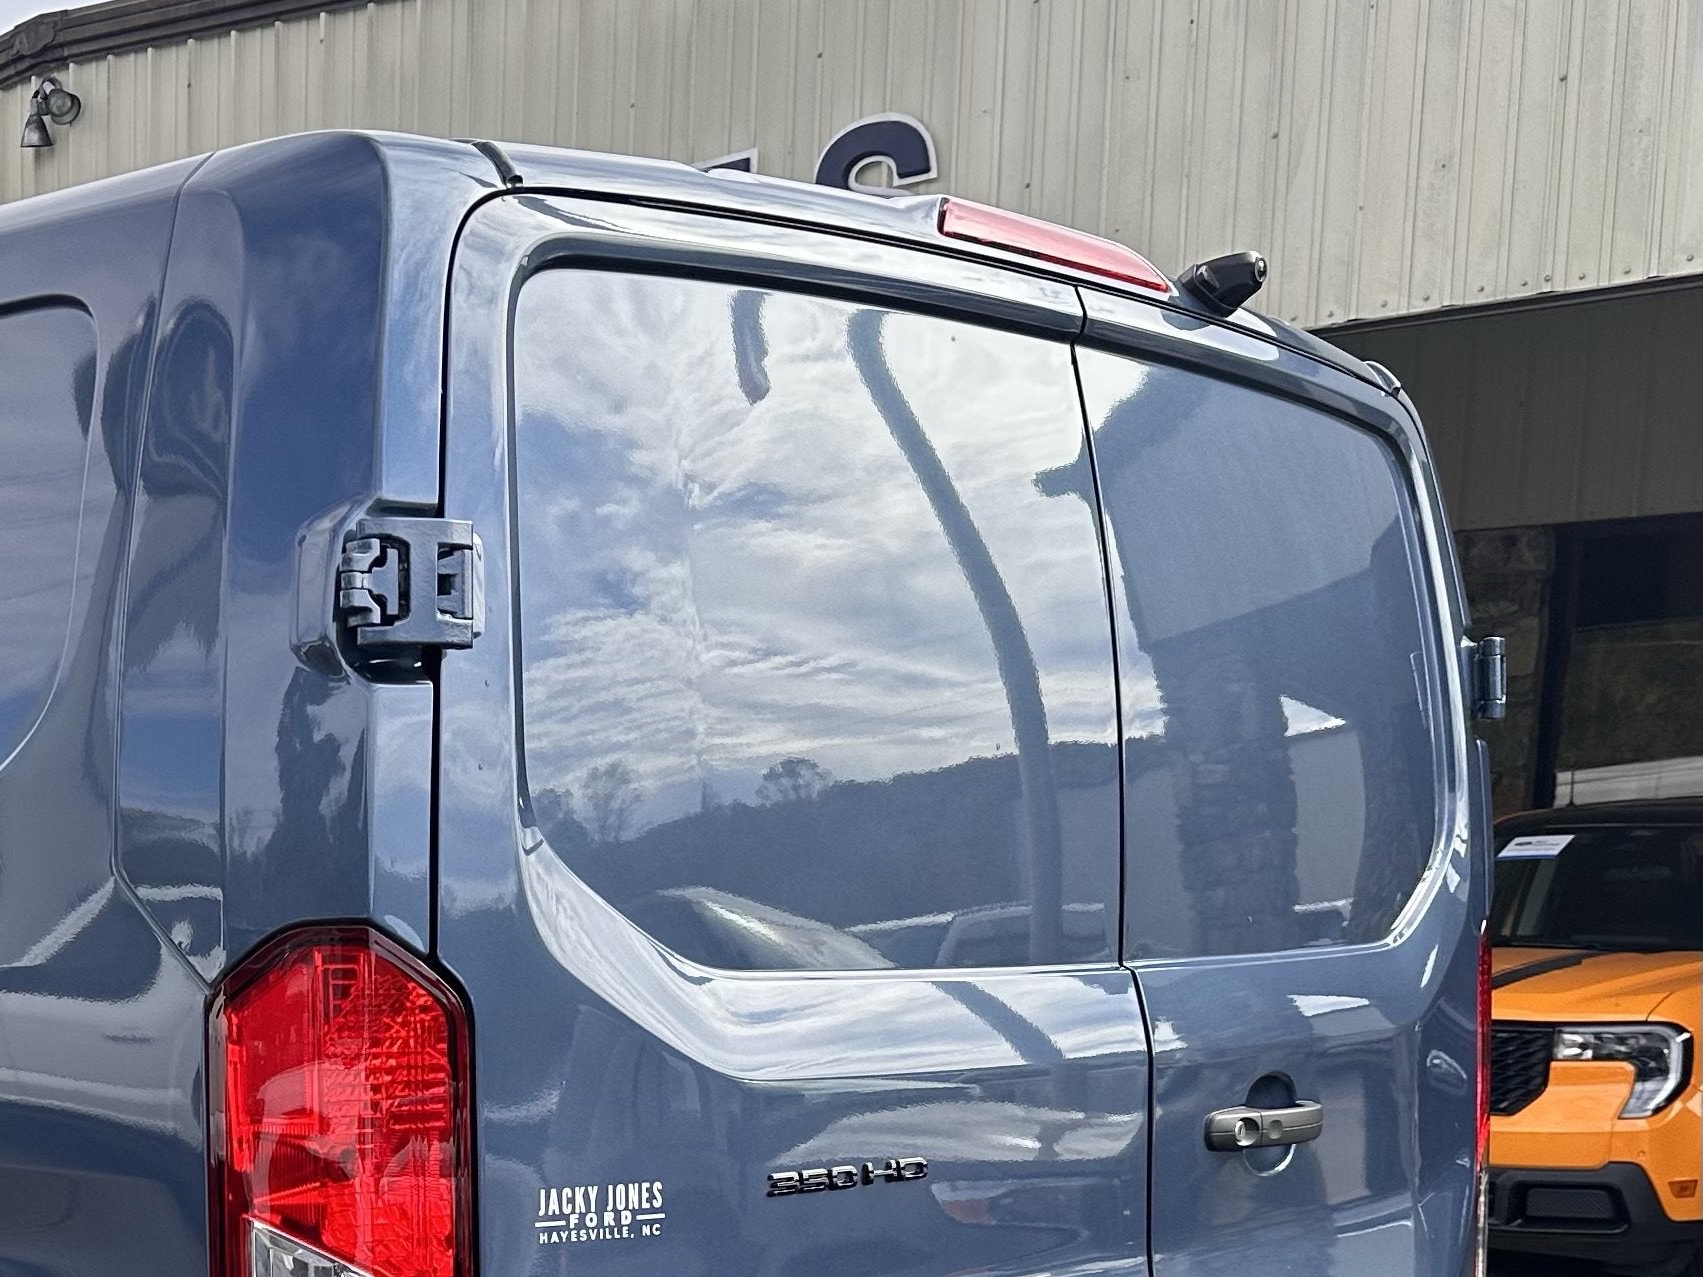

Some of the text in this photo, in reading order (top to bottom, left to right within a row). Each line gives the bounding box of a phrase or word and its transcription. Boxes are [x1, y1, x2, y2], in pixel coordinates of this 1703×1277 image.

[538, 1181, 663, 1217] JACKY JONES
[569, 1210, 632, 1229] FORD
[539, 1223, 661, 1245] HAYESVILLE, NC
